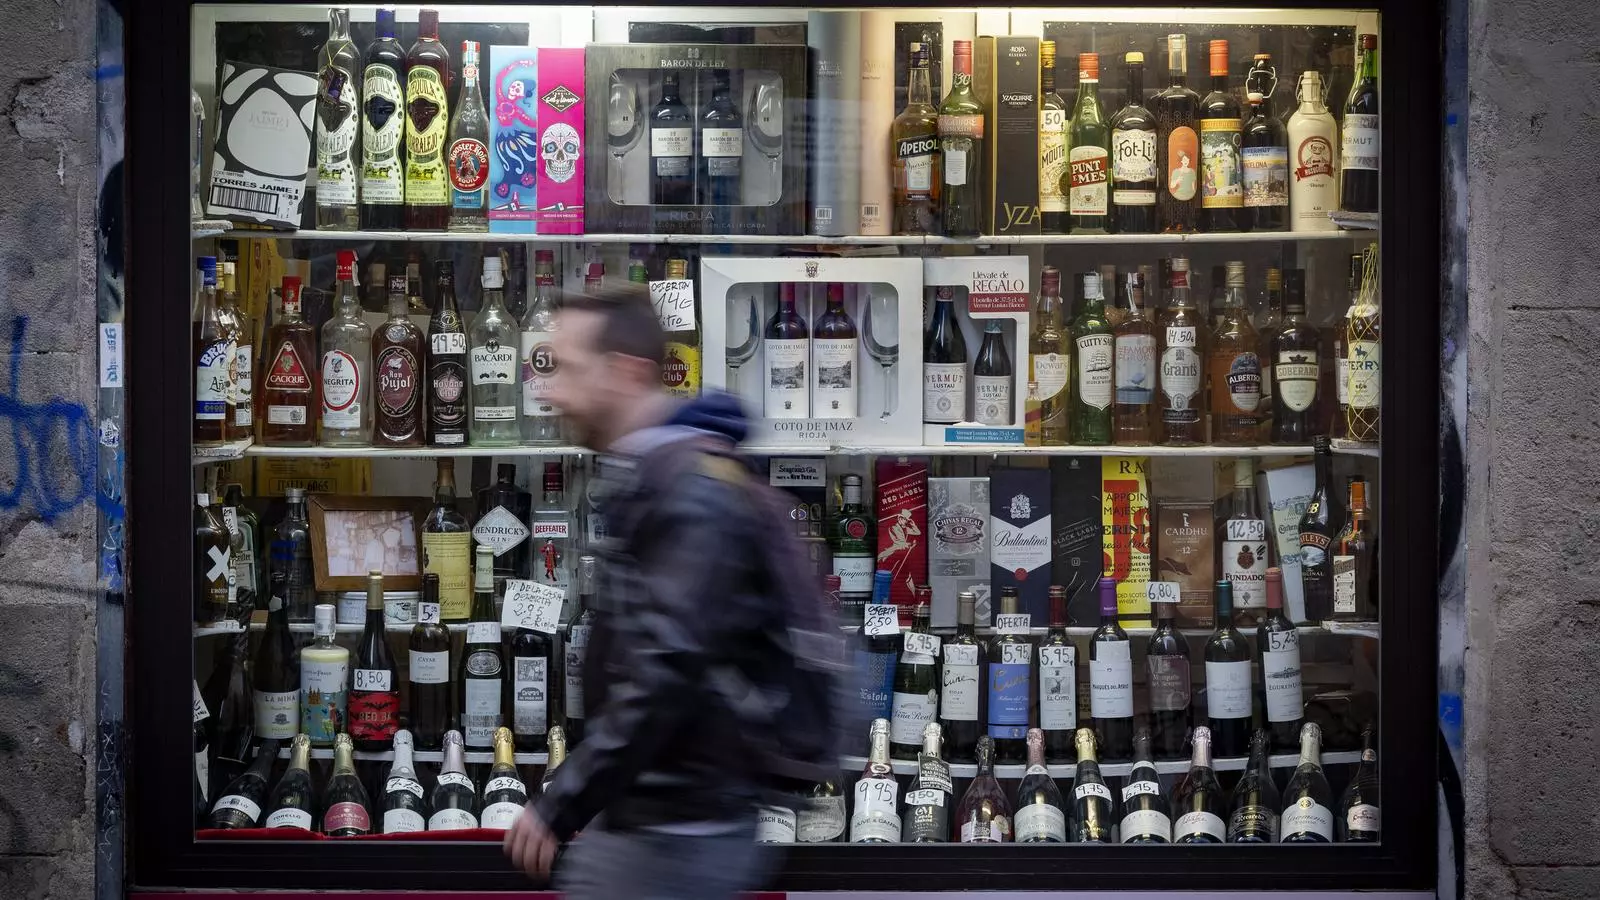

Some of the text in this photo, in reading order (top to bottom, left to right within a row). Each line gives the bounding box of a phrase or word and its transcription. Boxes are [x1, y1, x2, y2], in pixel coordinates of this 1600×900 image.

[900, 139, 939, 156] APEROL
[1072, 160, 1101, 174] PUNT
[1078, 171, 1106, 183] MES
[213, 177, 257, 189] TORRES
[259, 183, 293, 194] JAIME
[973, 280, 1024, 292] REGALO
[200, 343, 229, 366] BRU
[474, 354, 512, 362] BACARDI
[535, 353, 553, 368] 51
[1278, 367, 1317, 376] SOBERANO
[270, 375, 304, 384] CACIQUE
[381, 374, 410, 391] Pujol
[926, 374, 963, 383] VERMUT
[774, 422, 853, 431] COTO DE IMAZ
[899, 487, 924, 499] LABEL
[1106, 493, 1148, 501] APPOIN
[936, 517, 982, 527] CHIVAS REGAL
[475, 526, 525, 535] HENDRICK'S
[535, 524, 566, 534] BEEFEATER
[1165, 528, 1208, 536] CARDHU
[993, 531, 1048, 546] Ballantine's
[1225, 573, 1265, 581] FUNDADO
[998, 616, 1029, 629] OFERTA
